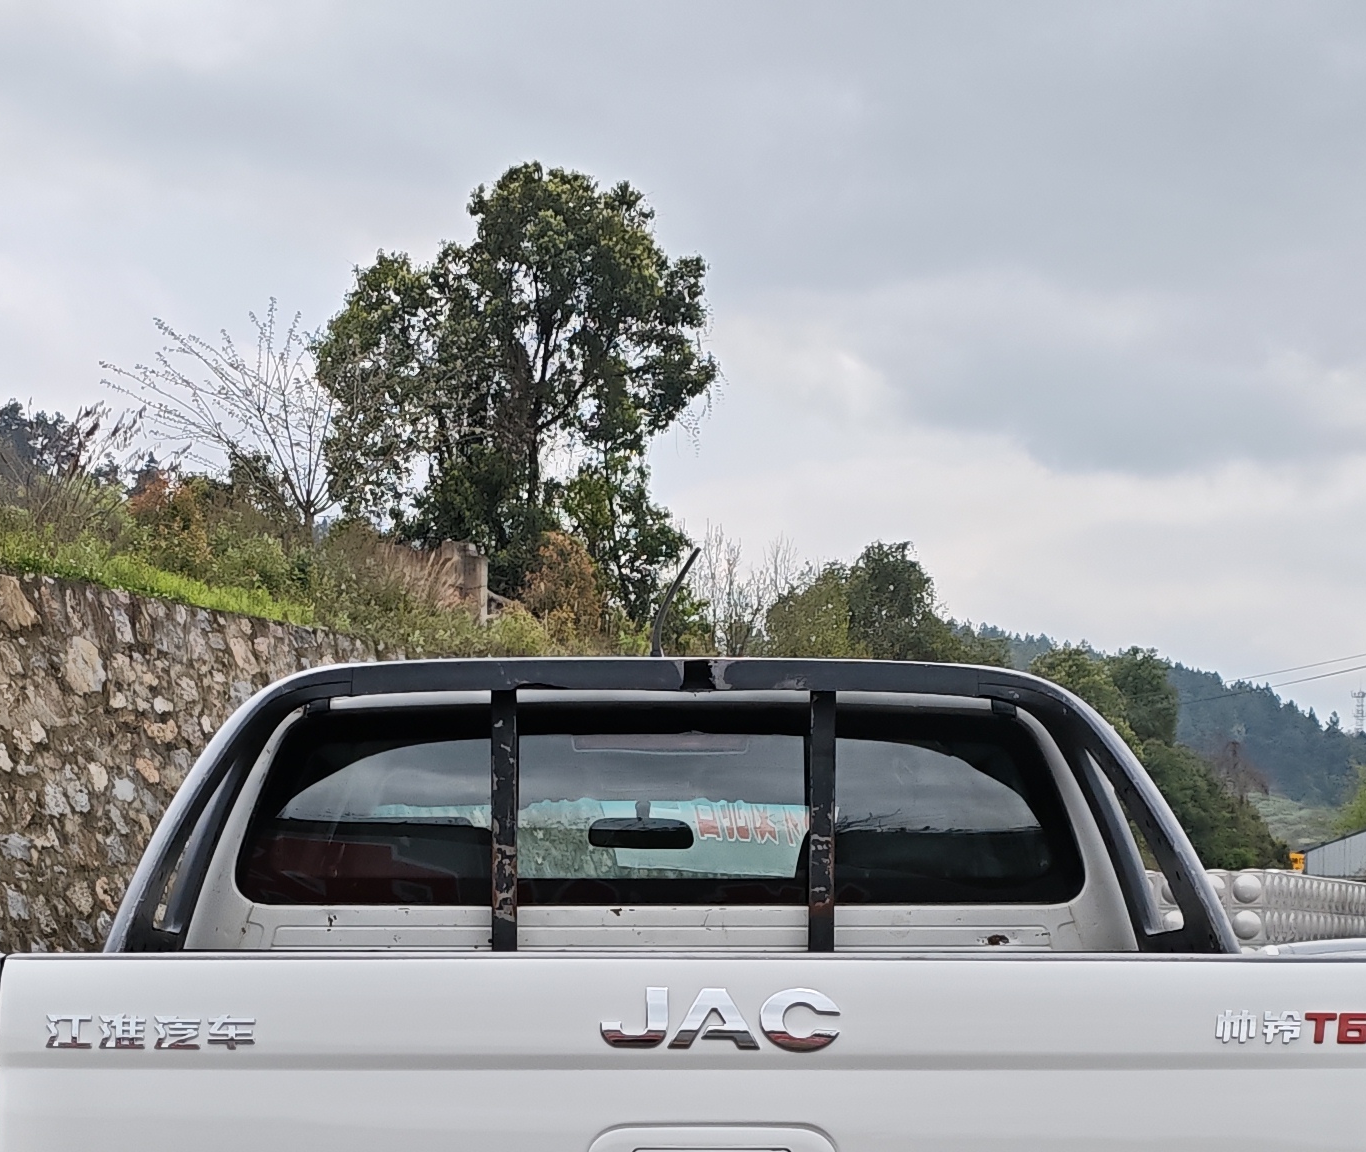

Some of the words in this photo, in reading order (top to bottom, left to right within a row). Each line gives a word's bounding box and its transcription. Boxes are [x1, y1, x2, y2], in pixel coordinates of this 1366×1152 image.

[45, 1013, 256, 1050] 江淮汽车
[599, 986, 841, 1053] JAC
